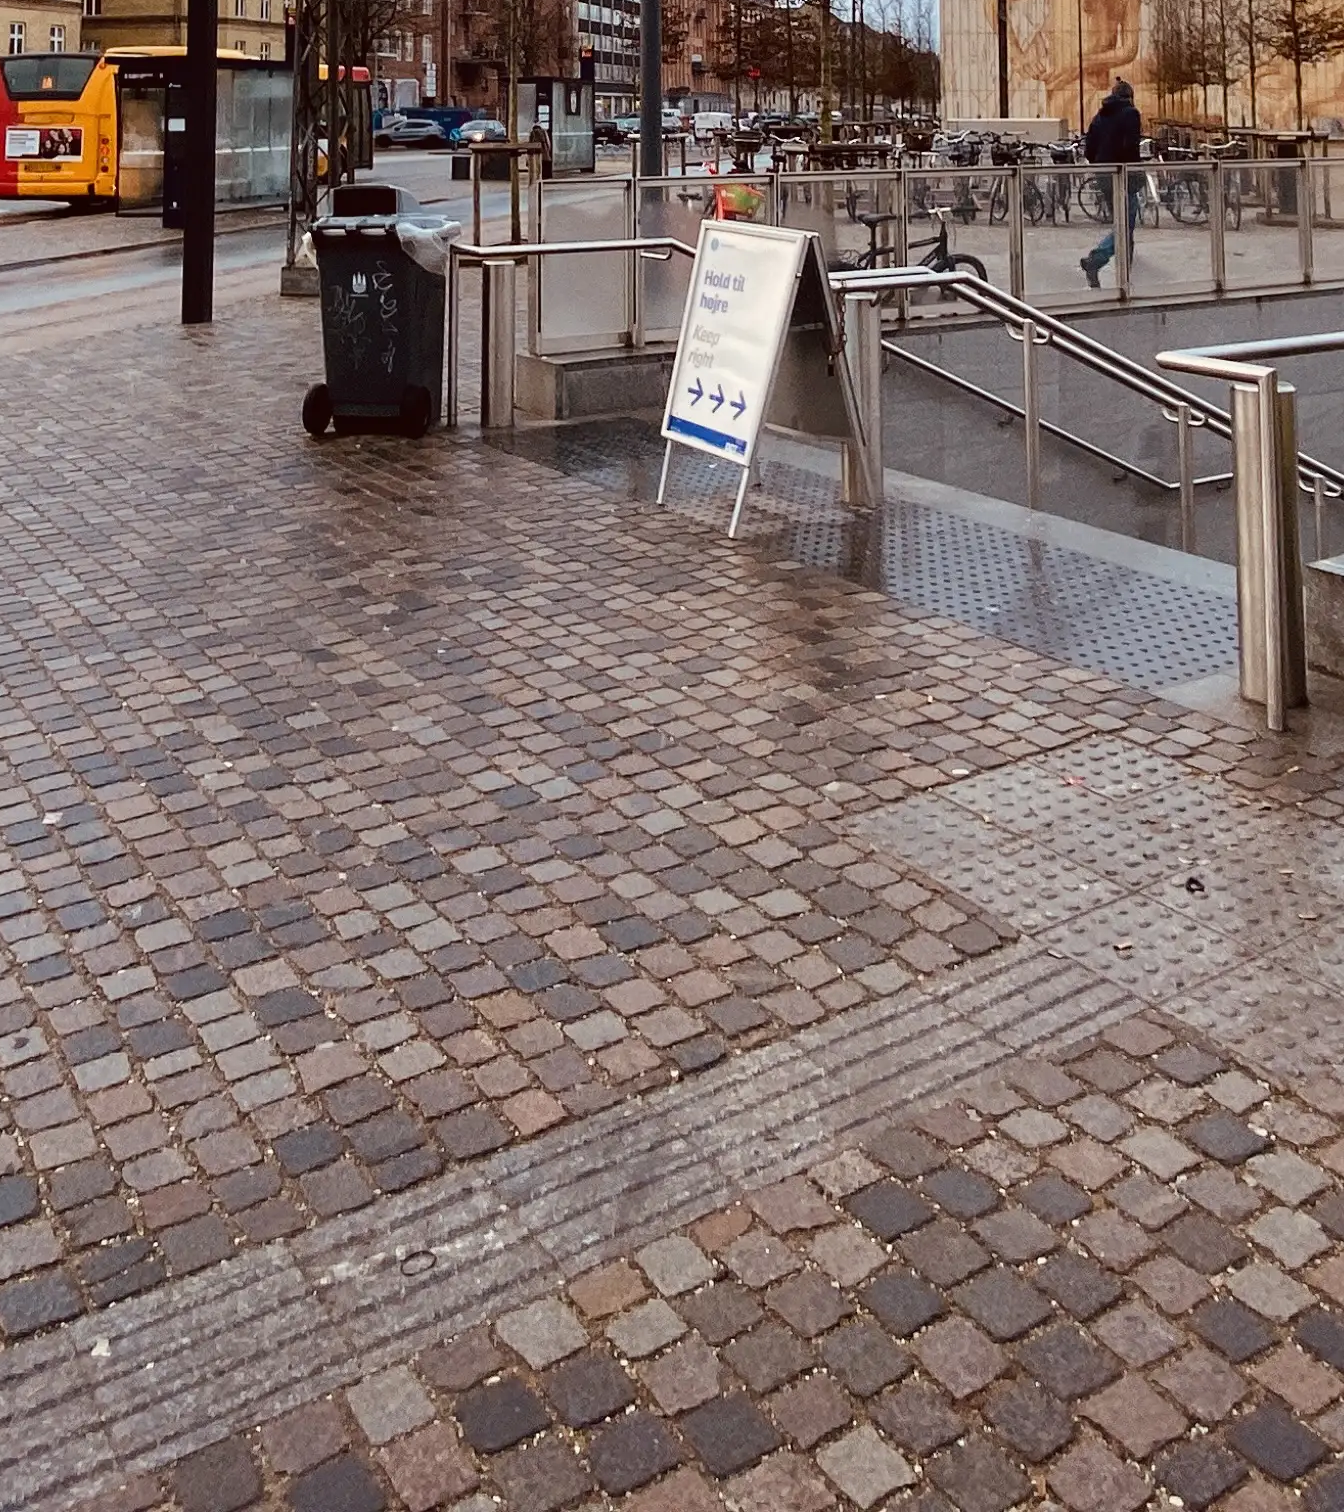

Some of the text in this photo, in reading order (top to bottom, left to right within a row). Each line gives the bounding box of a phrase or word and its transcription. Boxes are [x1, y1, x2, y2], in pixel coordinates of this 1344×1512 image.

[704, 269, 745, 293] Hold til
[692, 323, 721, 348] Keep
[687, 347, 715, 370] right
